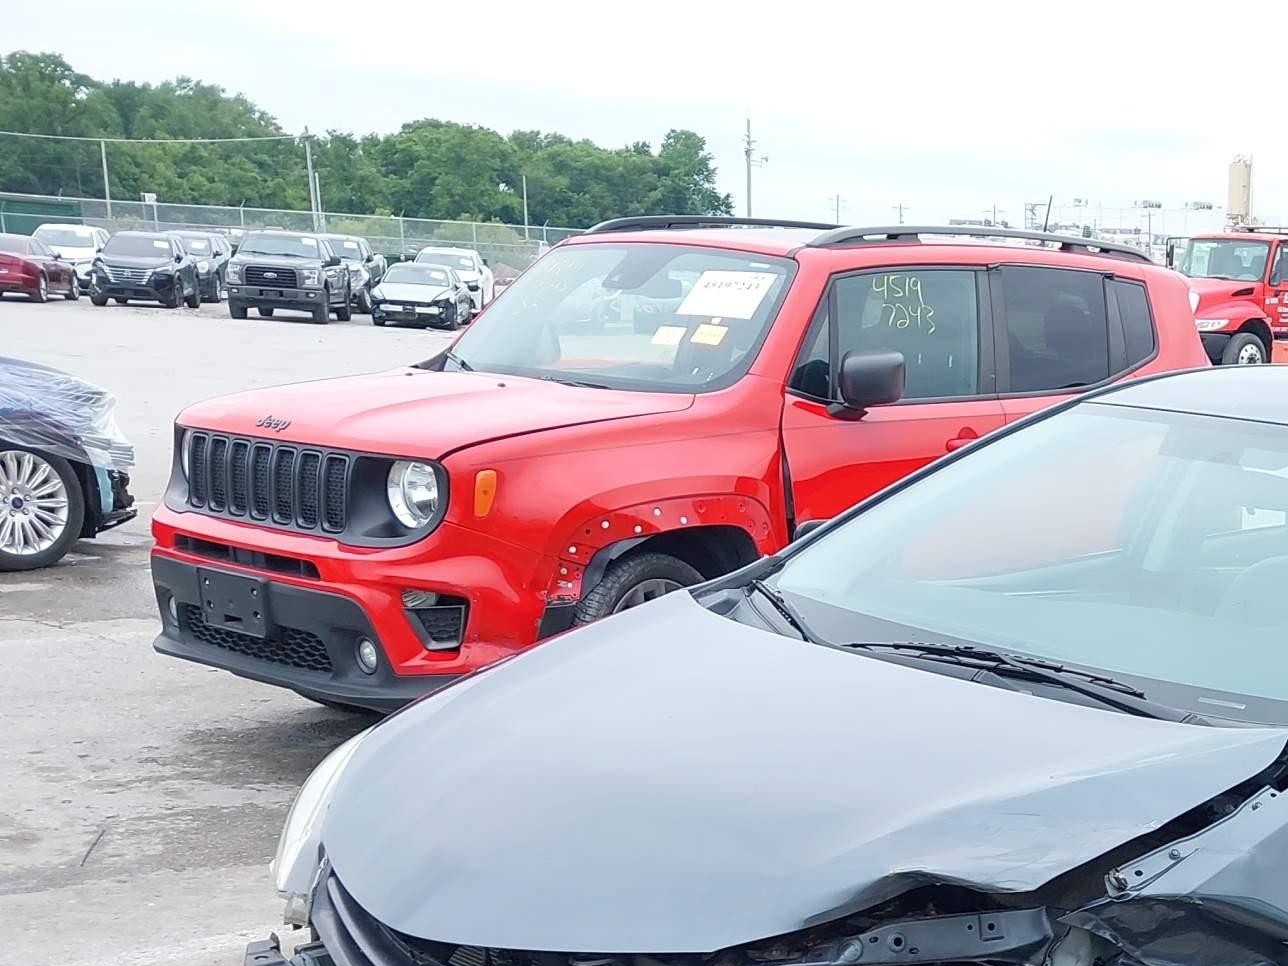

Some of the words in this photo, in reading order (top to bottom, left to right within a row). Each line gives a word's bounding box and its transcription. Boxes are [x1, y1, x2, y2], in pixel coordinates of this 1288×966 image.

[872, 275, 924, 306] 4519
[882, 303, 936, 335] 7243
[256, 415, 292, 433] Jeep
